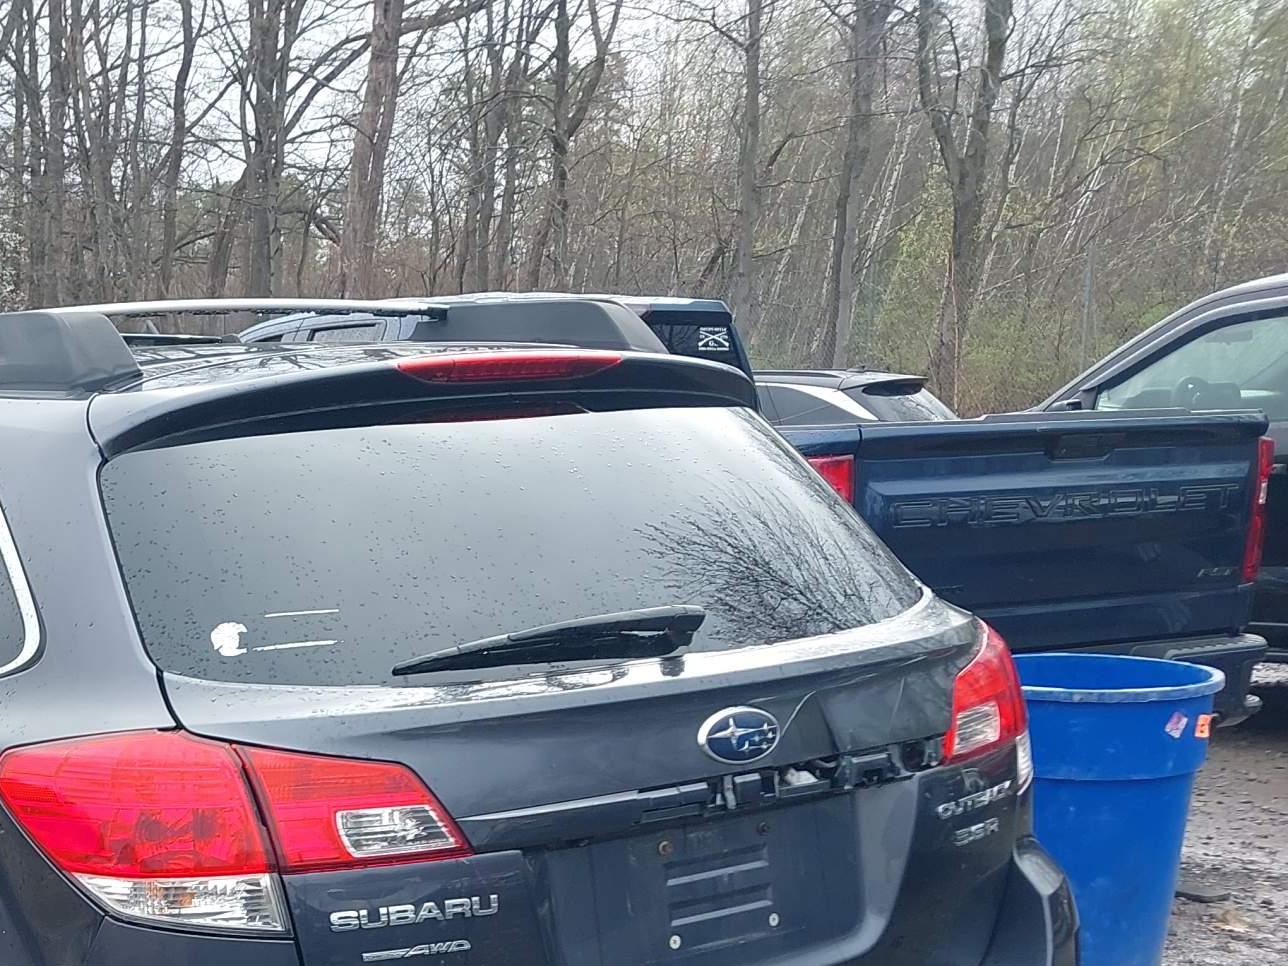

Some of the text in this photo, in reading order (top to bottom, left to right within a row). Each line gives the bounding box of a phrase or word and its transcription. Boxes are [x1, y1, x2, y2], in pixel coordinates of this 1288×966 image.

[891, 483, 1239, 529] CHEVROLET
[329, 895, 499, 932] SUBARU
[404, 940, 471, 957] AWD
